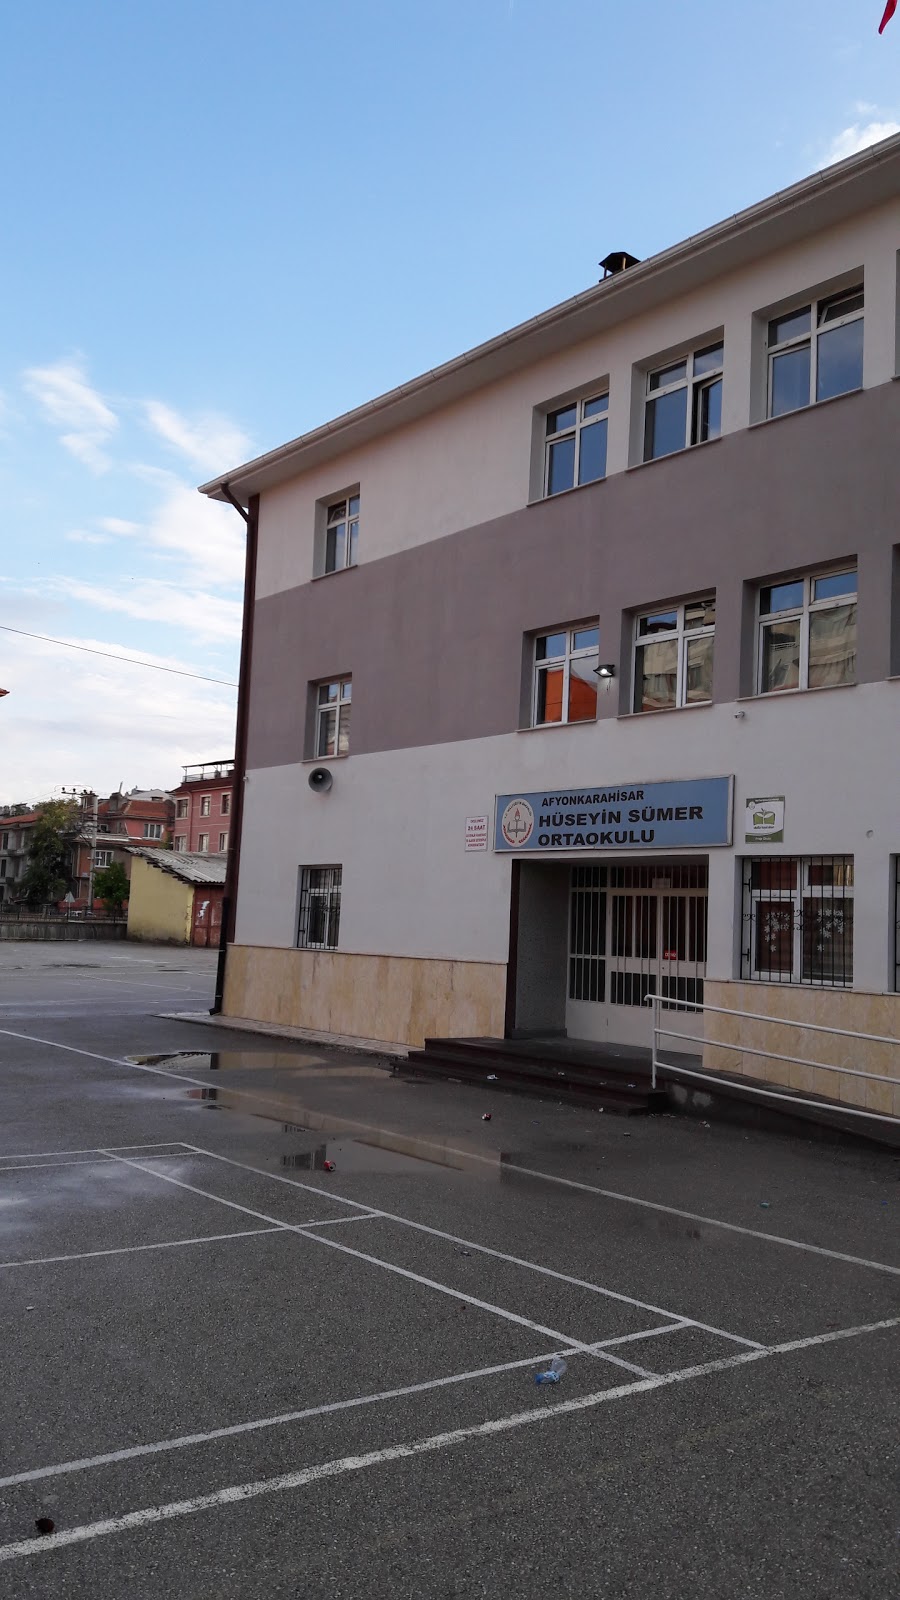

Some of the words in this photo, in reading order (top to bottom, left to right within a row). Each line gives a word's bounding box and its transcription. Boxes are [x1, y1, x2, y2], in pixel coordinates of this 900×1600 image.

[541, 790, 644, 807] AFYONKARAHİSAR
[539, 809, 621, 827] HÜSEYİN
[628, 806, 704, 823] SÜMER
[538, 829, 655, 846] ORTAOKULU
